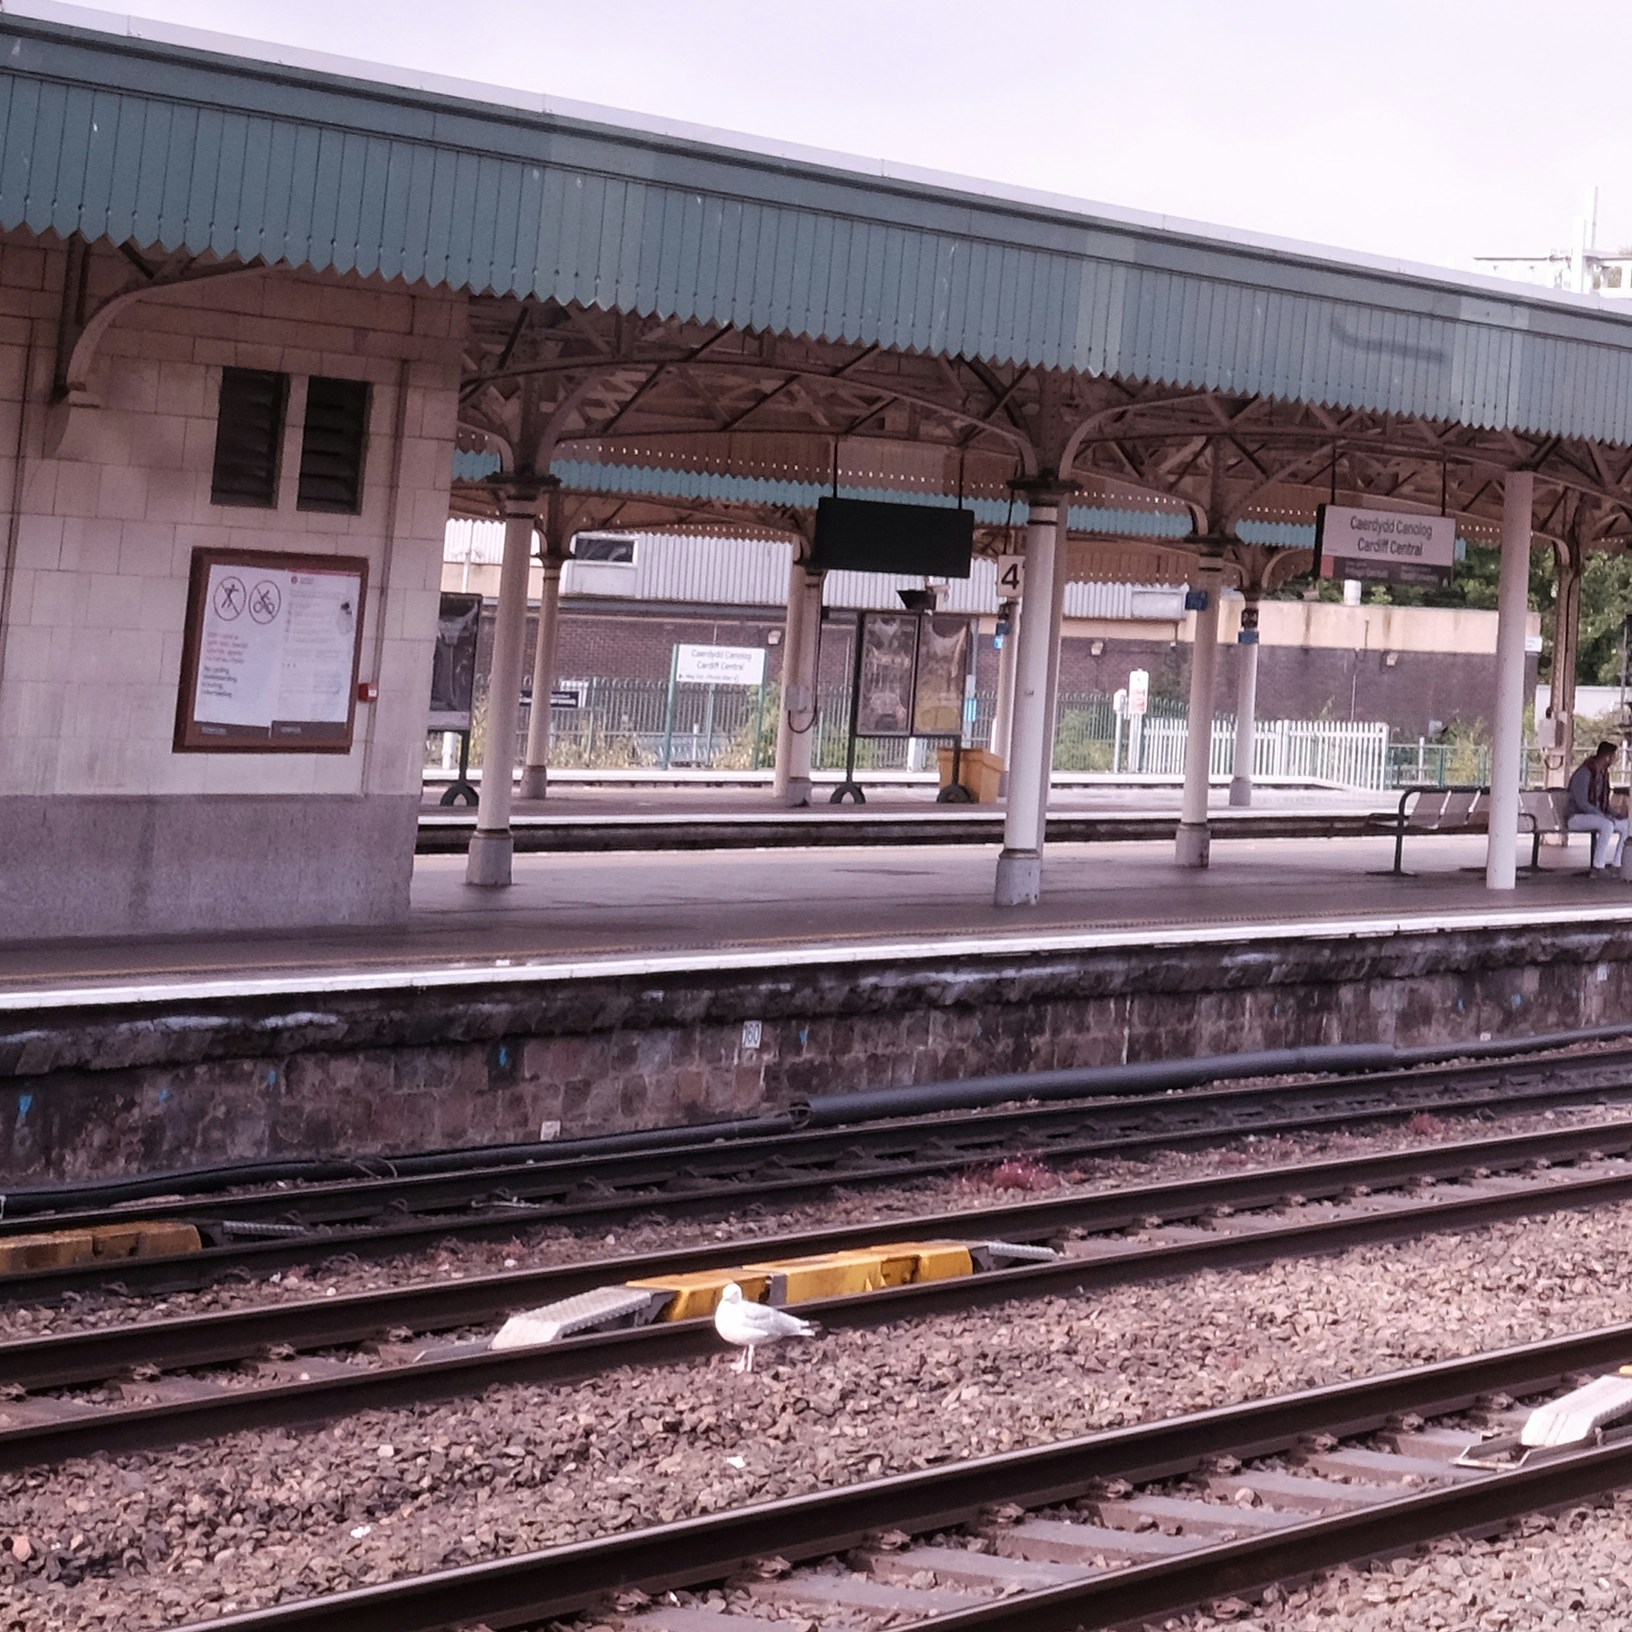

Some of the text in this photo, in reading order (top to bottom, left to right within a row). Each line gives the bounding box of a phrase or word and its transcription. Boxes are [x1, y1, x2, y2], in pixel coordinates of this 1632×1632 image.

[1351, 515, 1433, 540] Caerdydd Canolog
[1358, 537, 1423, 556] Cardiff Central
[1001, 563, 1020, 590] 4
